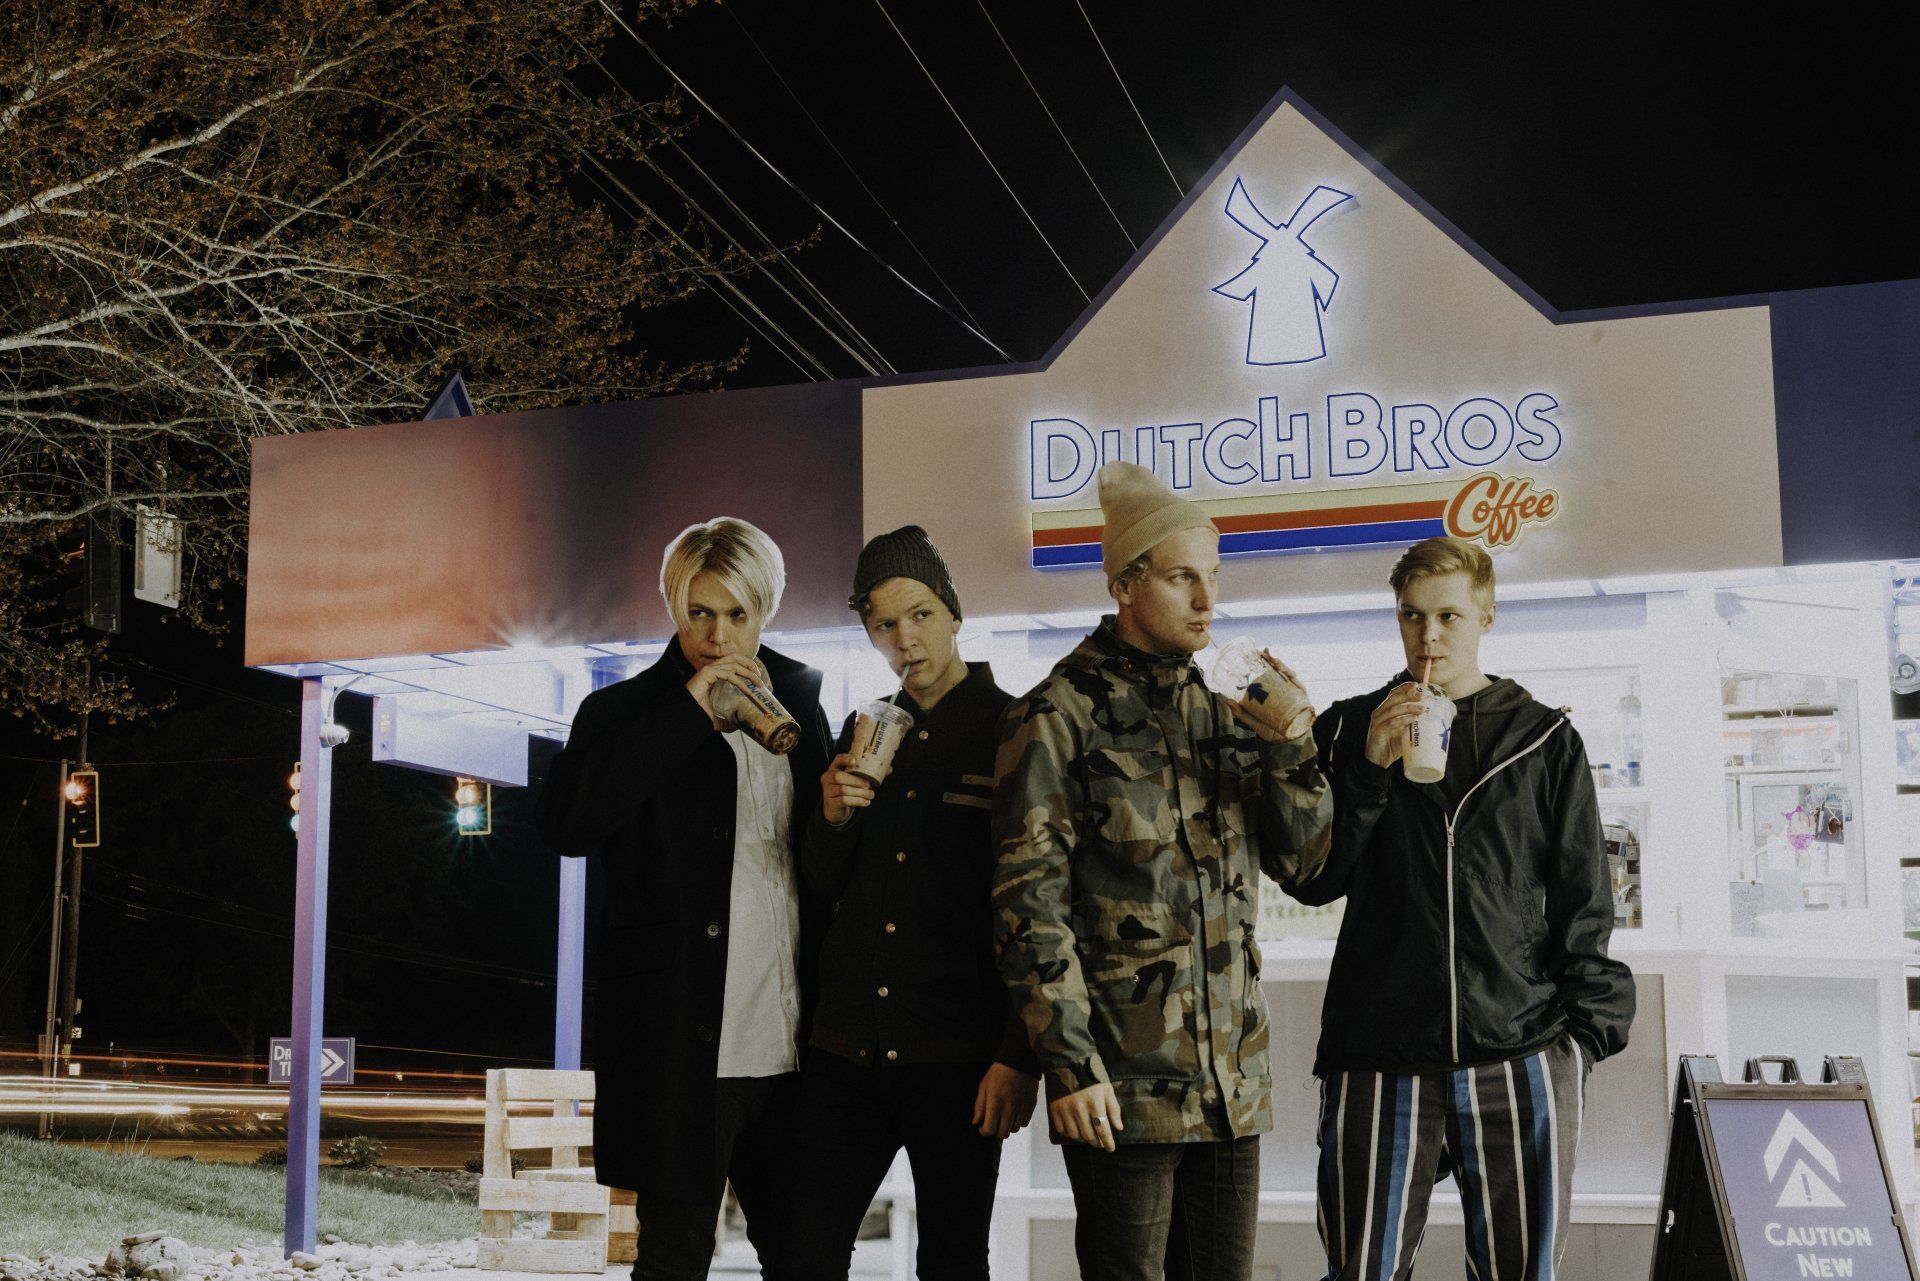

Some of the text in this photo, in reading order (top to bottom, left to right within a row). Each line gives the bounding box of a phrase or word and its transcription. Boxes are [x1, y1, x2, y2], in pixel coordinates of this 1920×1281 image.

[1031, 393, 1562, 499] DUTCH BROS
[1448, 476, 1554, 545] Coffee
[1764, 1222, 1872, 1247] CAUTION
[1796, 1253, 1853, 1278] NEW
